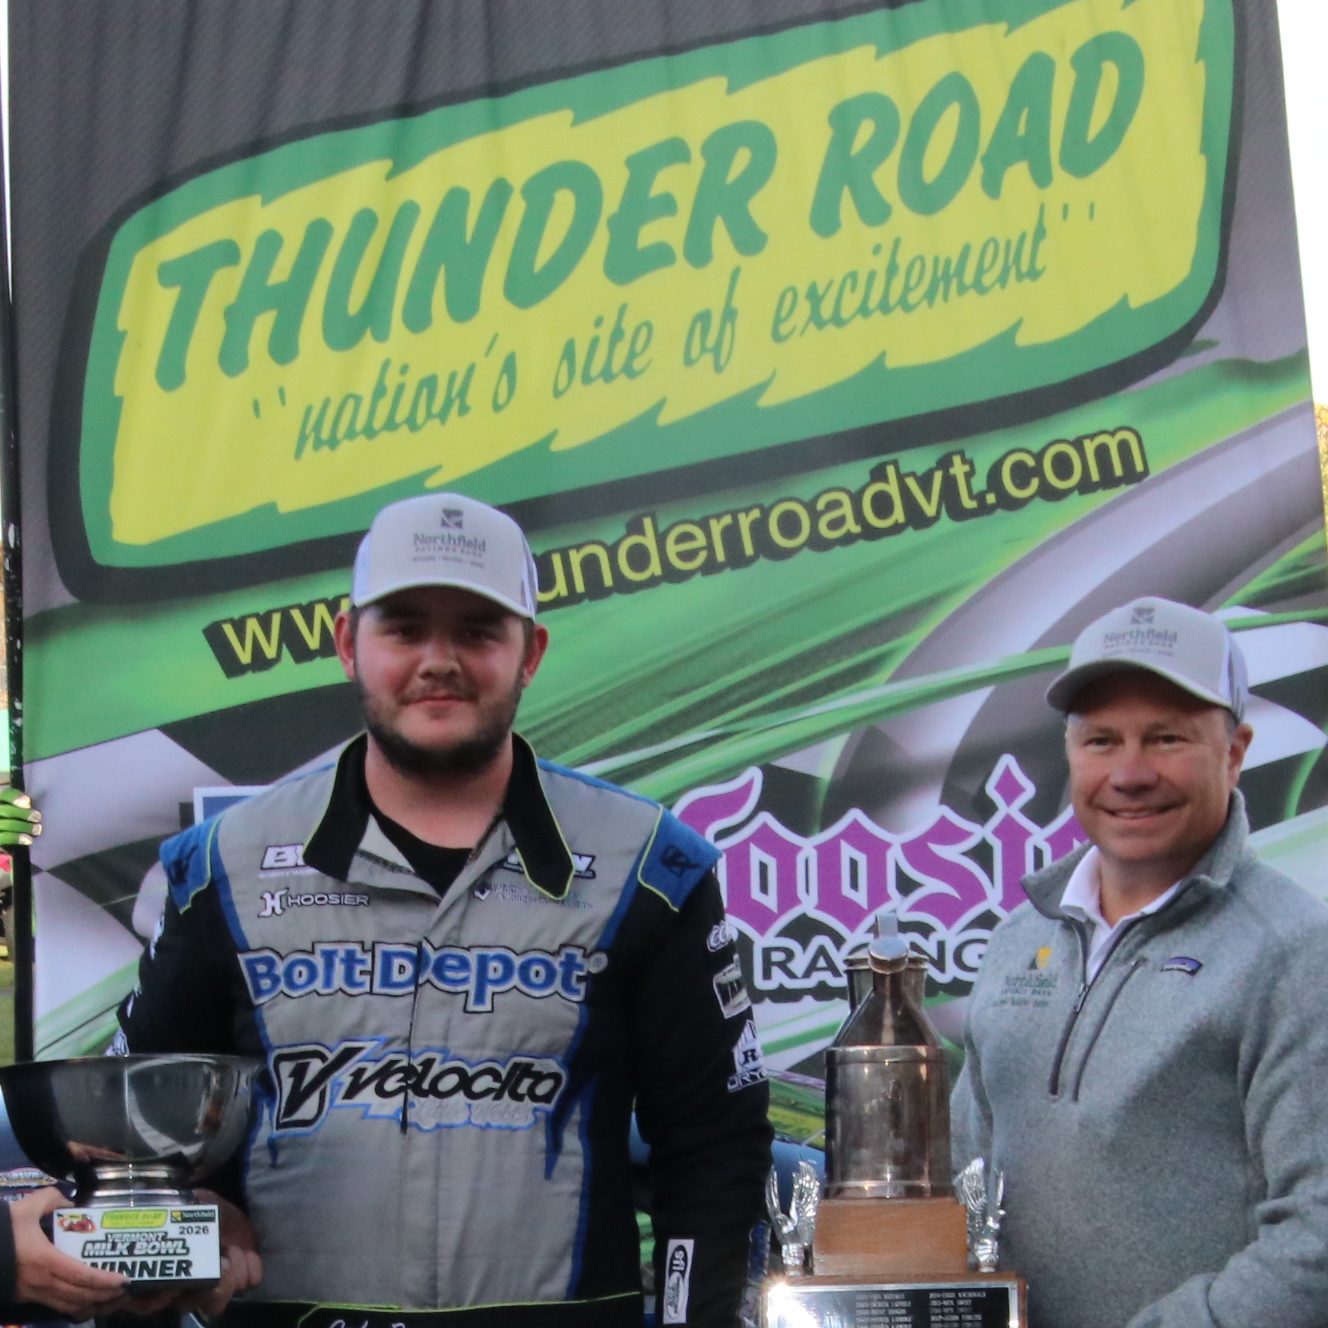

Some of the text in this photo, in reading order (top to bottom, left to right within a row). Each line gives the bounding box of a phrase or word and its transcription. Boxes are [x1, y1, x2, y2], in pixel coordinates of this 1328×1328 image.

[155, 31, 1145, 392] THUNDER ROAD
[553, 303, 654, 399] site
[683, 265, 741, 375] of
[413, 533, 486, 552] Northfield
[288, 893, 370, 908] HOOSIER
[761, 938, 988, 982] RANG
[106, 1232, 166, 1243] VERMONT
[178, 1225, 210, 1235] 2026
[83, 1240, 190, 1257] MILK BOWL
